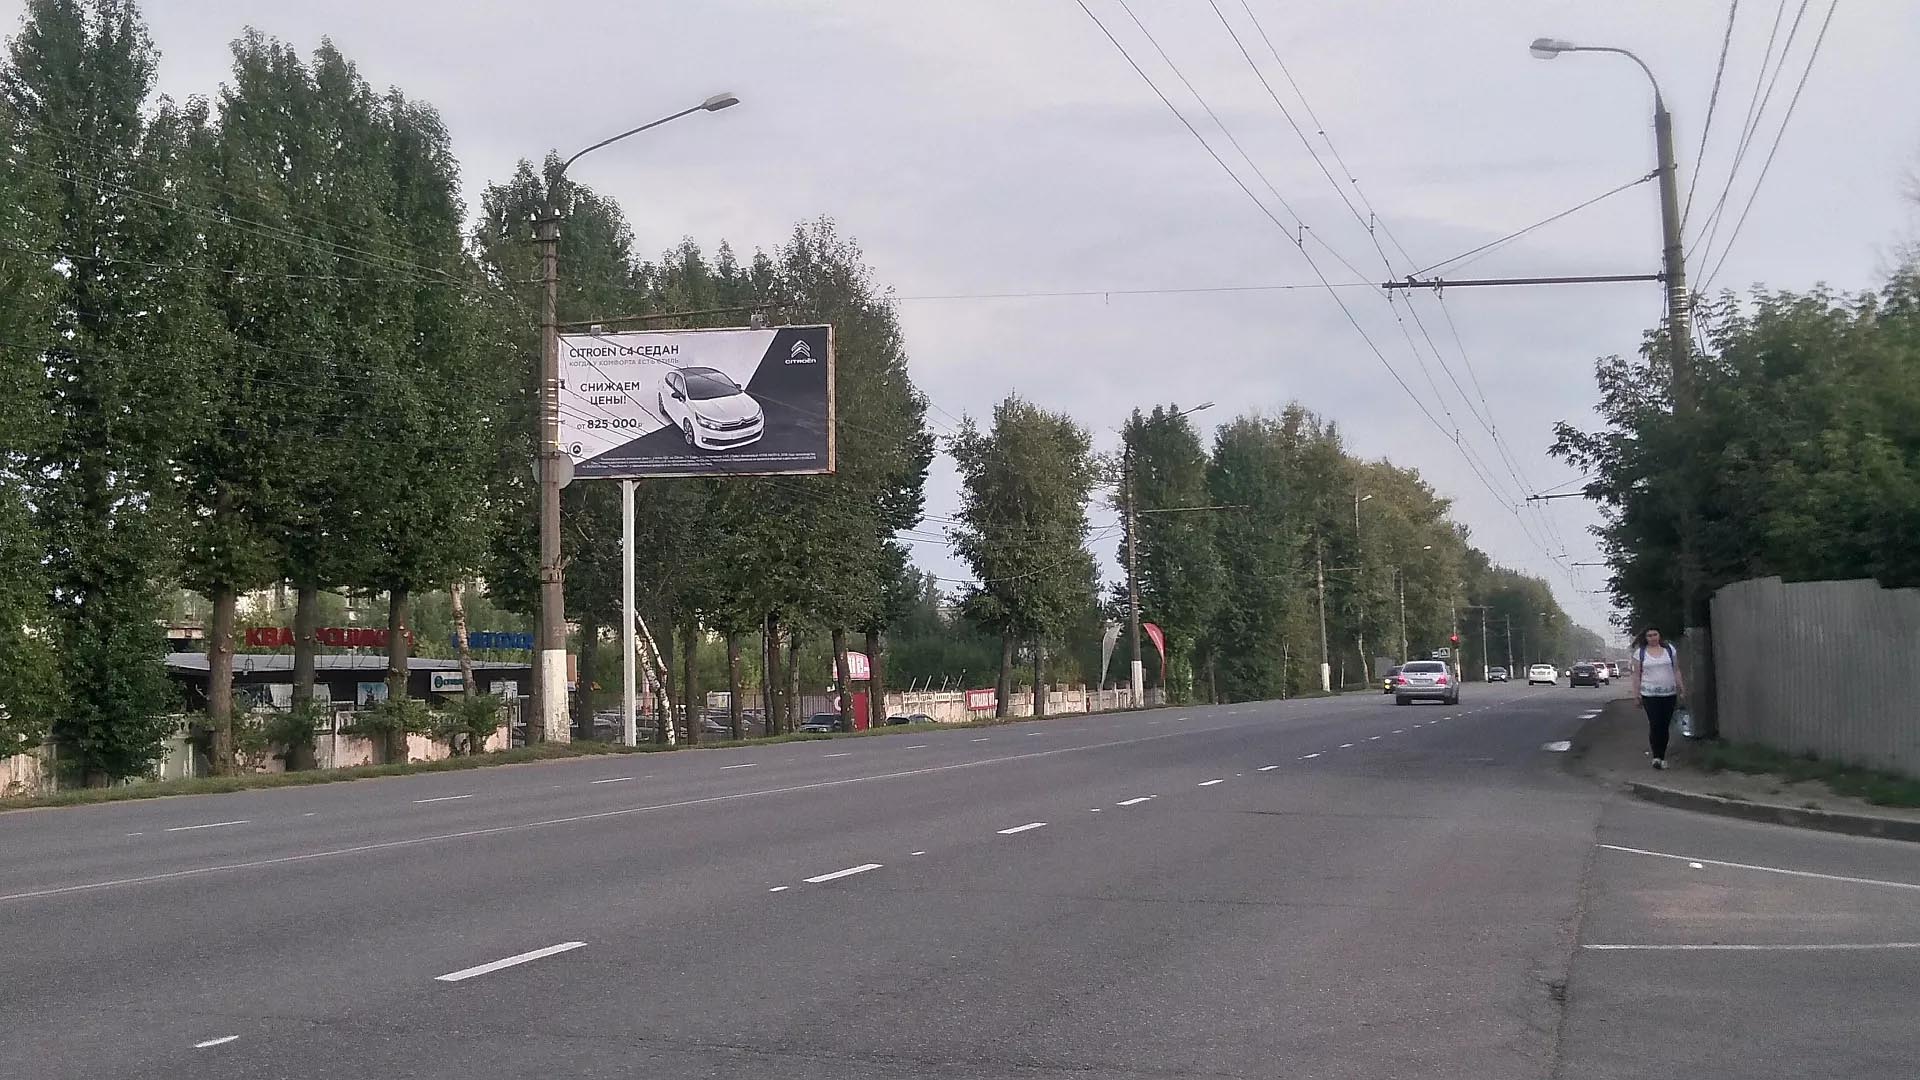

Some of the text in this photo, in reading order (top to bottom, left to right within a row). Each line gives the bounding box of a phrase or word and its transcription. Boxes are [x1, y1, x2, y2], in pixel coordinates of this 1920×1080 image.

[569, 345, 679, 358] CITROËN C4 СЕДАН
[599, 359, 636, 367] КОМФОРТА
[580, 382, 640, 392] СНИЖАЕМ
[590, 395, 627, 406] ЦЕНЫ!
[587, 418, 608, 429] 825
[612, 418, 637, 428] 000
